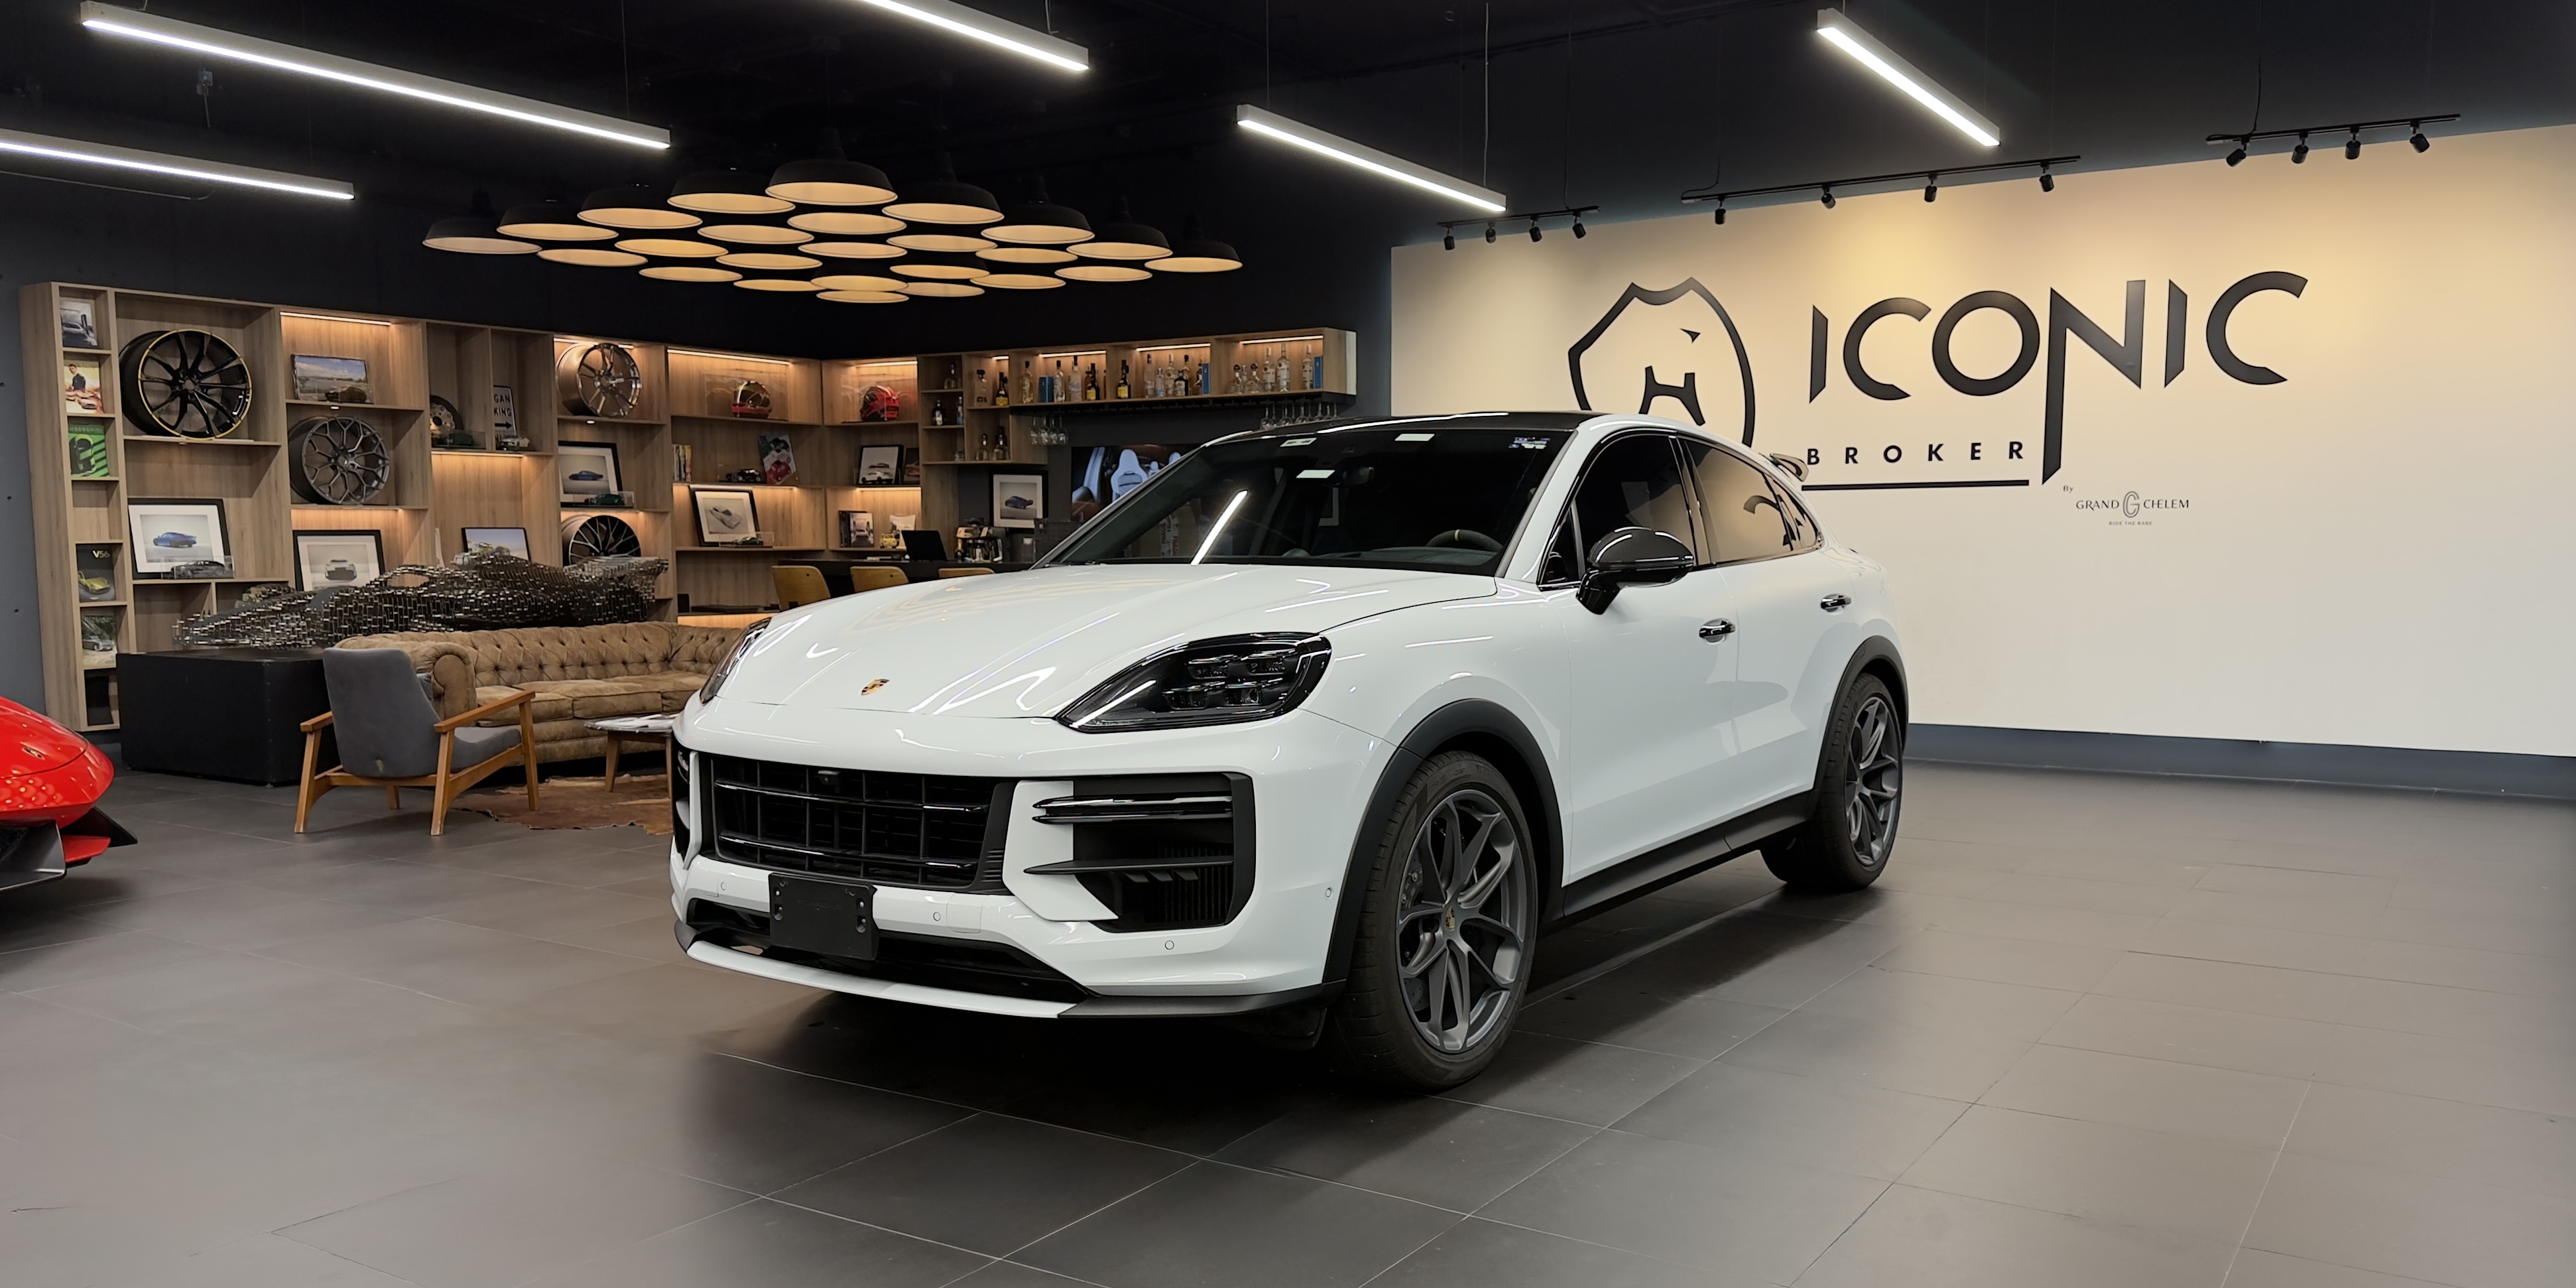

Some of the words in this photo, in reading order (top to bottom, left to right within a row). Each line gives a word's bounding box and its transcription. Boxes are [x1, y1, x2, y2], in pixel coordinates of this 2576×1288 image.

[1809, 271, 2307, 485] ICONIC
[1808, 442, 2023, 465] BROKER
[2063, 485, 2073, 493] By
[2076, 499, 2120, 511] GRAND
[2143, 499, 2189, 509] CHELEM
